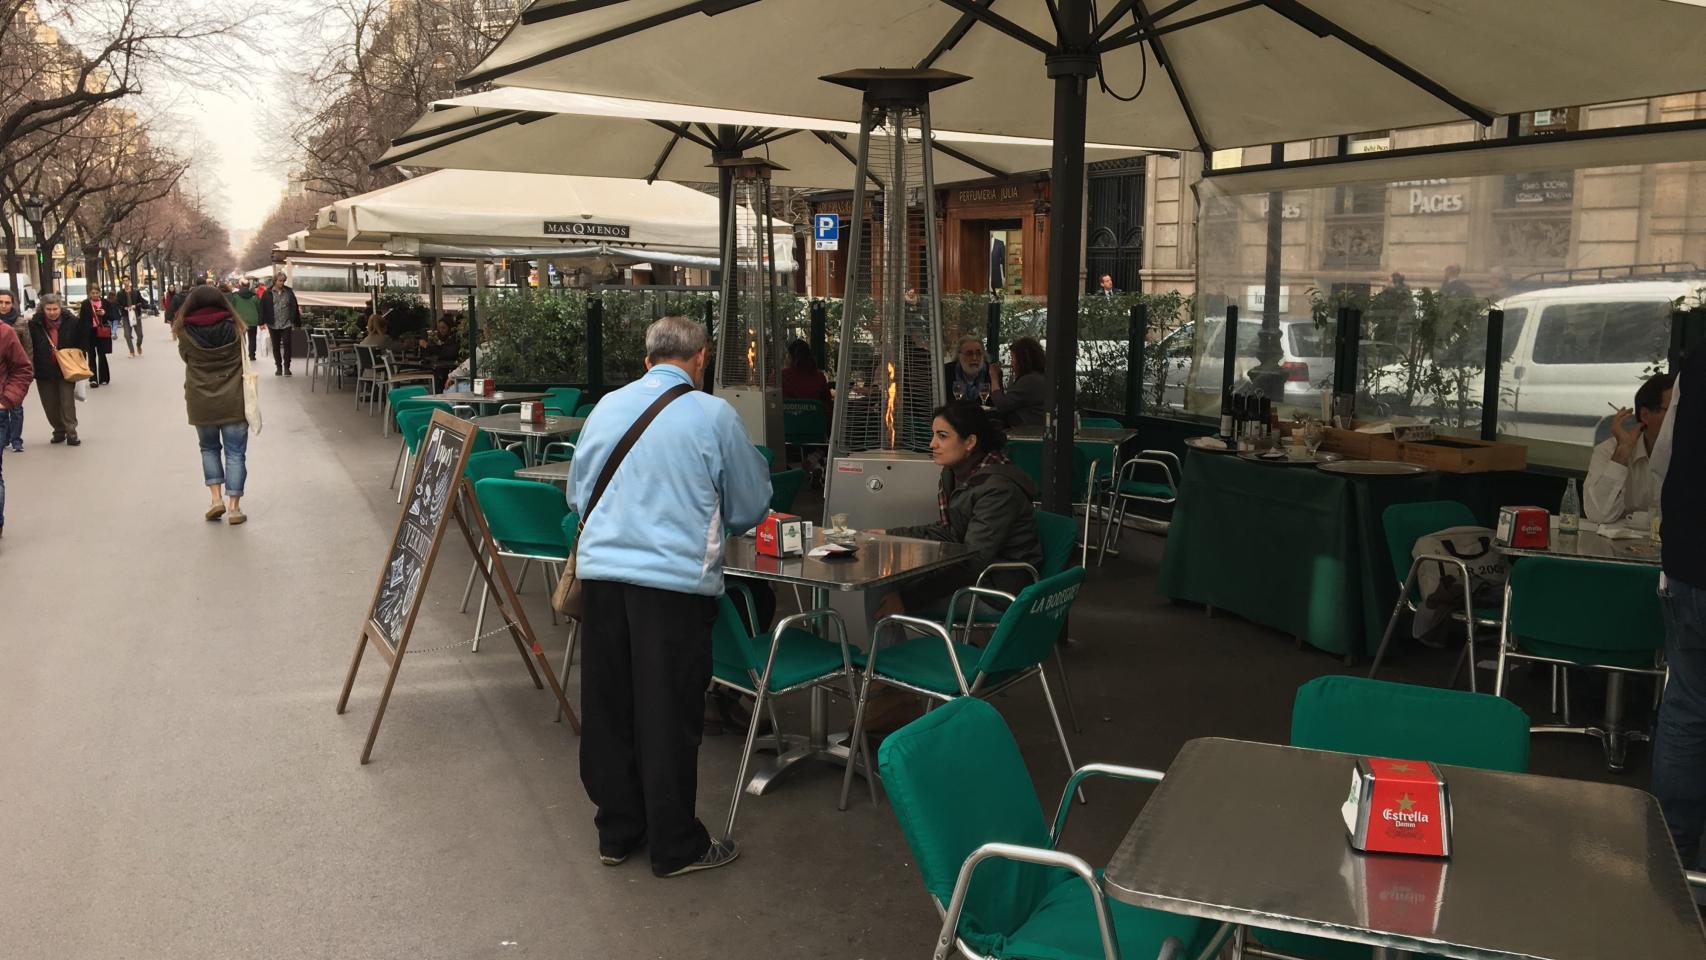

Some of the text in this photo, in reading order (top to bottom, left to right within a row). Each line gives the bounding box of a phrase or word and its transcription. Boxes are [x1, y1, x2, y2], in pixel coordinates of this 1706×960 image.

[1409, 189, 1463, 214] PAGES
[819, 217, 834, 237] P
[1382, 808, 1429, 823] Estrella
